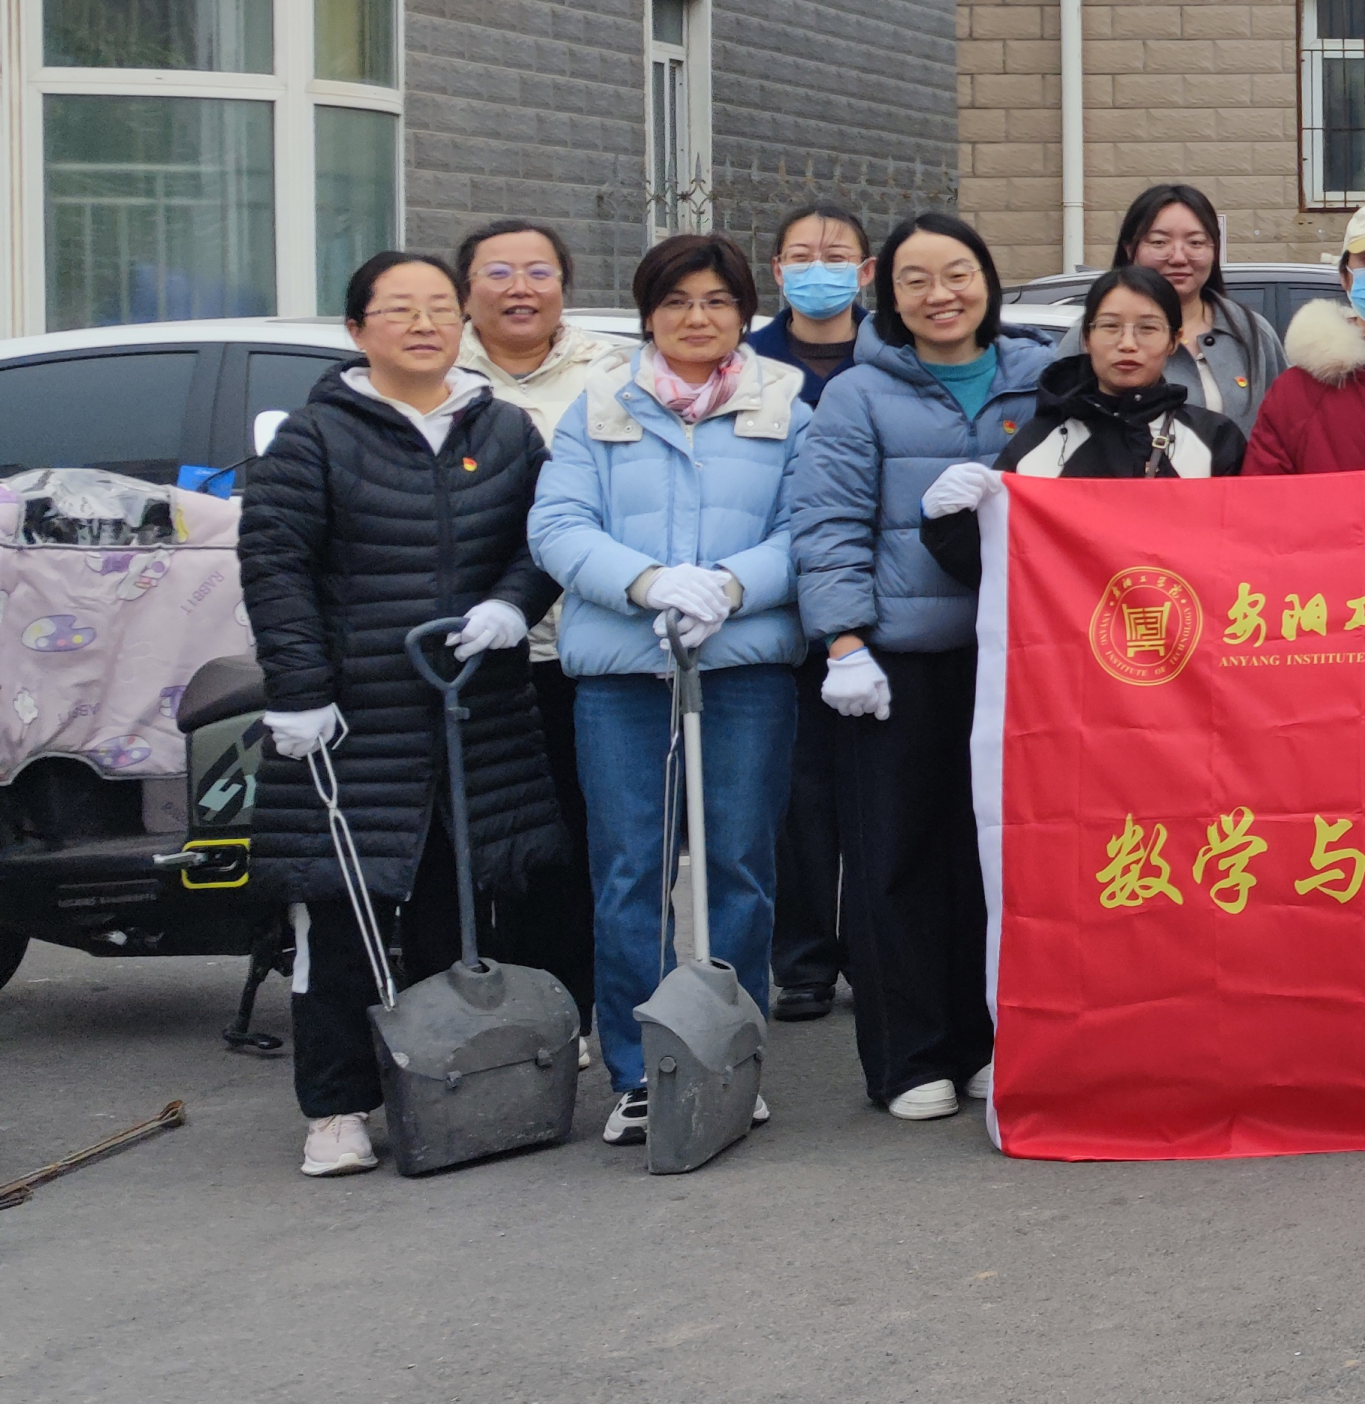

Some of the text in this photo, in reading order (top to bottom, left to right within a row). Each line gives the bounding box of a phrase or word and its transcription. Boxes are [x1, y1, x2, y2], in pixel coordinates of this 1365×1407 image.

[180, 570, 225, 615] RABBIT
[1218, 654, 1281, 667] ANYANG
[1286, 652, 1365, 666] INSTITUTE
